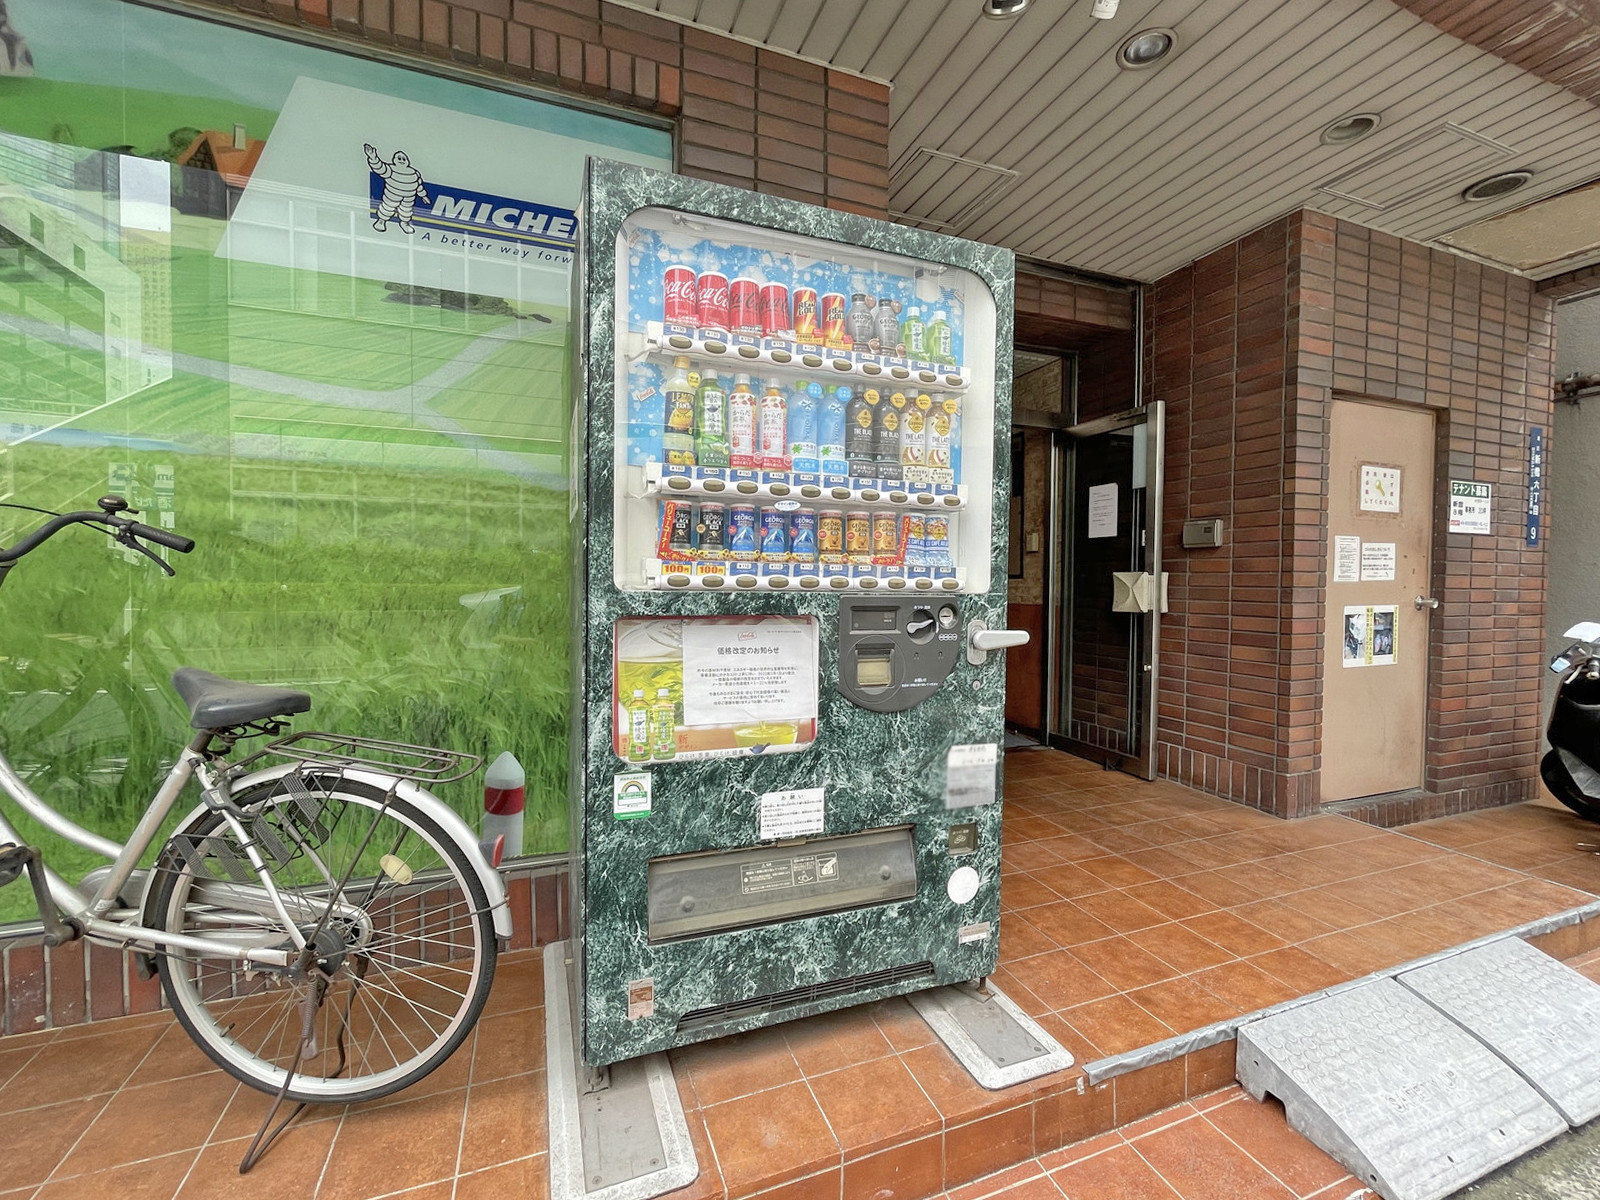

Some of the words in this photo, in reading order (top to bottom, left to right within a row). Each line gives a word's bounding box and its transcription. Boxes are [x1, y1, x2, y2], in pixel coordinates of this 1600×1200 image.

[421, 232, 431, 241] A
[440, 234, 493, 251] better
[500, 245, 530, 260] way
[1453, 483, 1488, 497] テナント募集
[1530, 527, 1537, 540] 9
[665, 565, 689, 573] 100円
[699, 566, 723, 574] 100円
[717, 647, 780, 655] 価格改定のお知らせ
